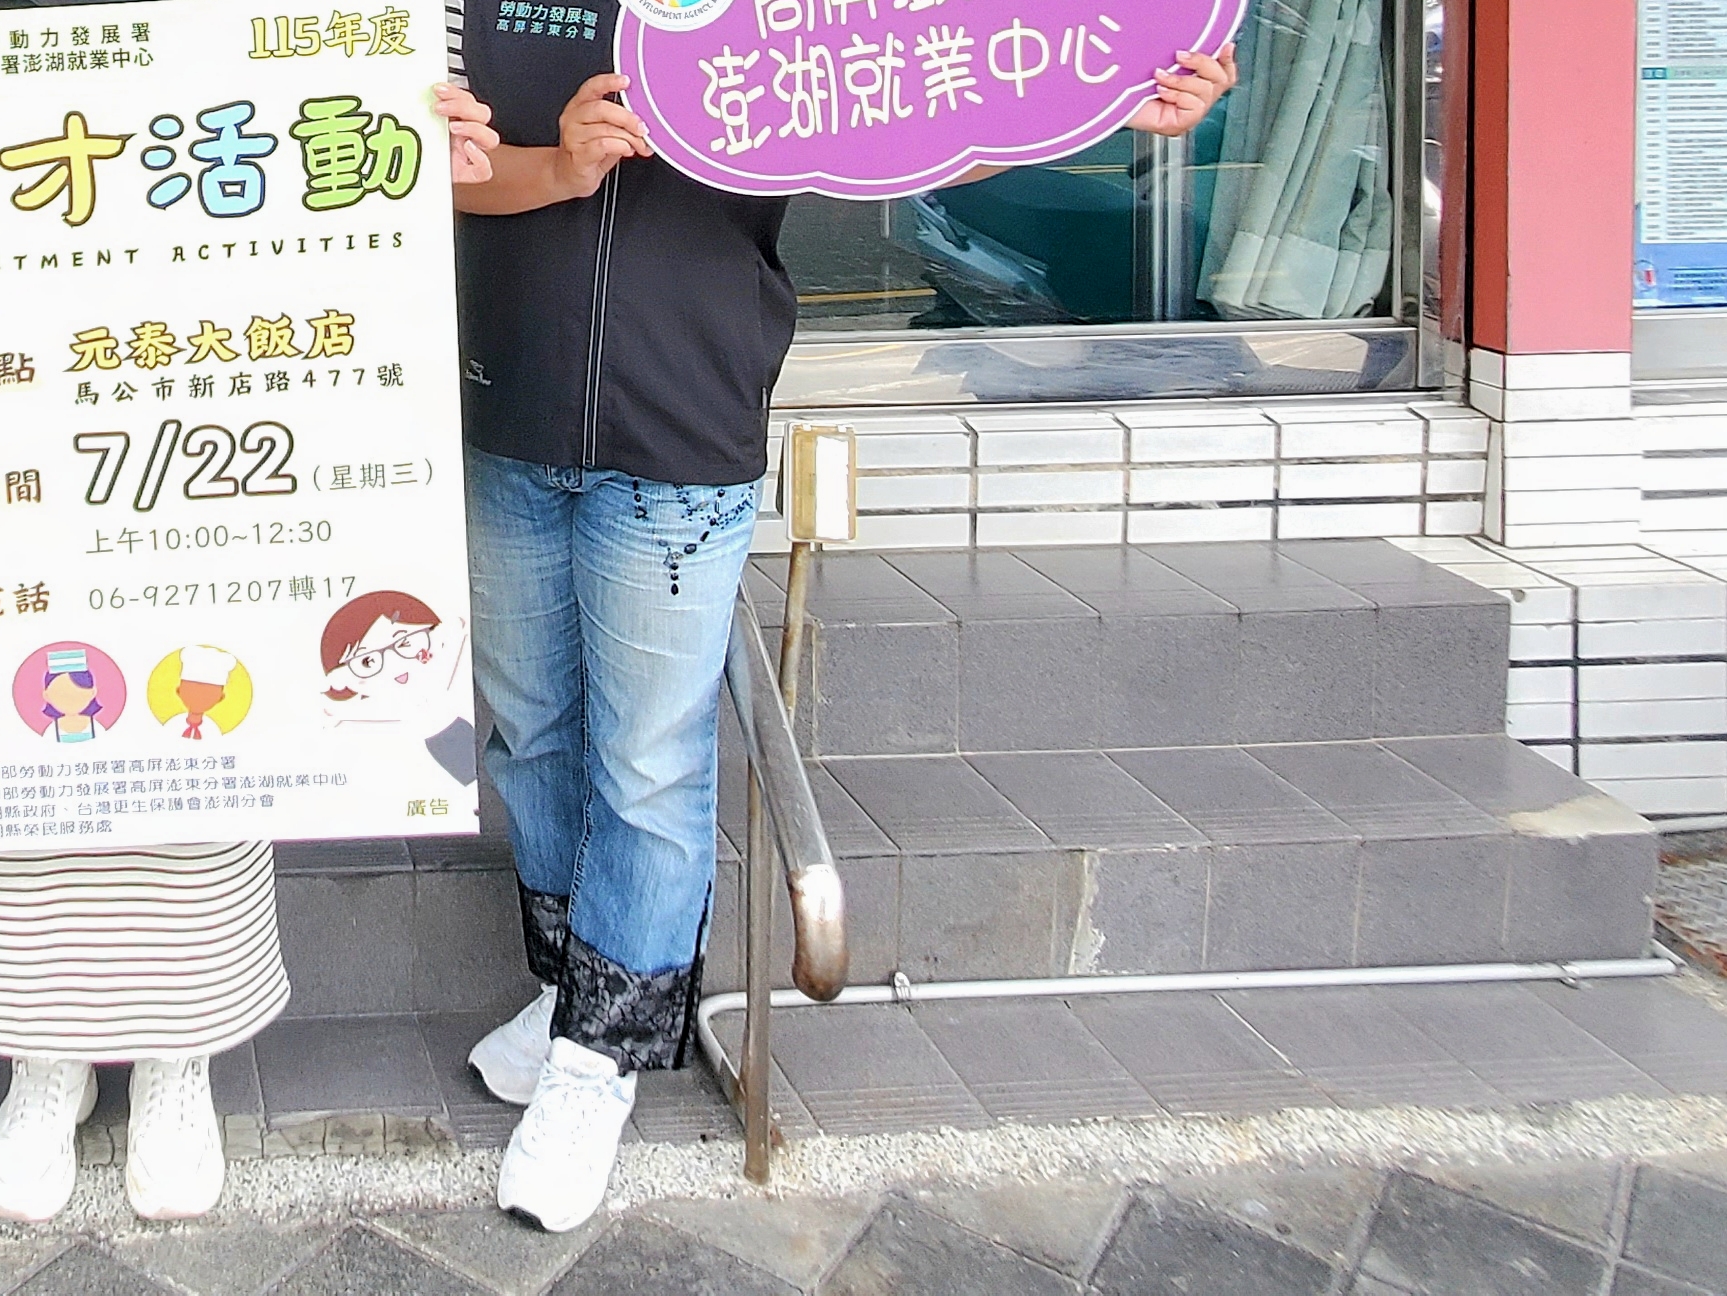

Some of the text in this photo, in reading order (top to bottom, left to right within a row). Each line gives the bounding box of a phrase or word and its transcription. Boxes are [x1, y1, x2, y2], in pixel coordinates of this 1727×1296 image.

[496, 19, 596, 41] 高屏澎東分署
[498, 0, 598, 27] 勞動力發展署
[250, 7, 416, 60] 115年度
[698, 13, 1122, 156] 澎湖就業中心
[171, 231, 406, 262] ACTIVITIES
[64, 308, 356, 374] 元泰大飯店
[74, 362, 406, 405] 馬公市新店路477號
[73, 419, 297, 513] 7/22
[85, 520, 333, 556] 上午10:00~12:30
[88, 574, 357, 611] 06-9271207轉17
[406, 798, 450, 818] 廣告
